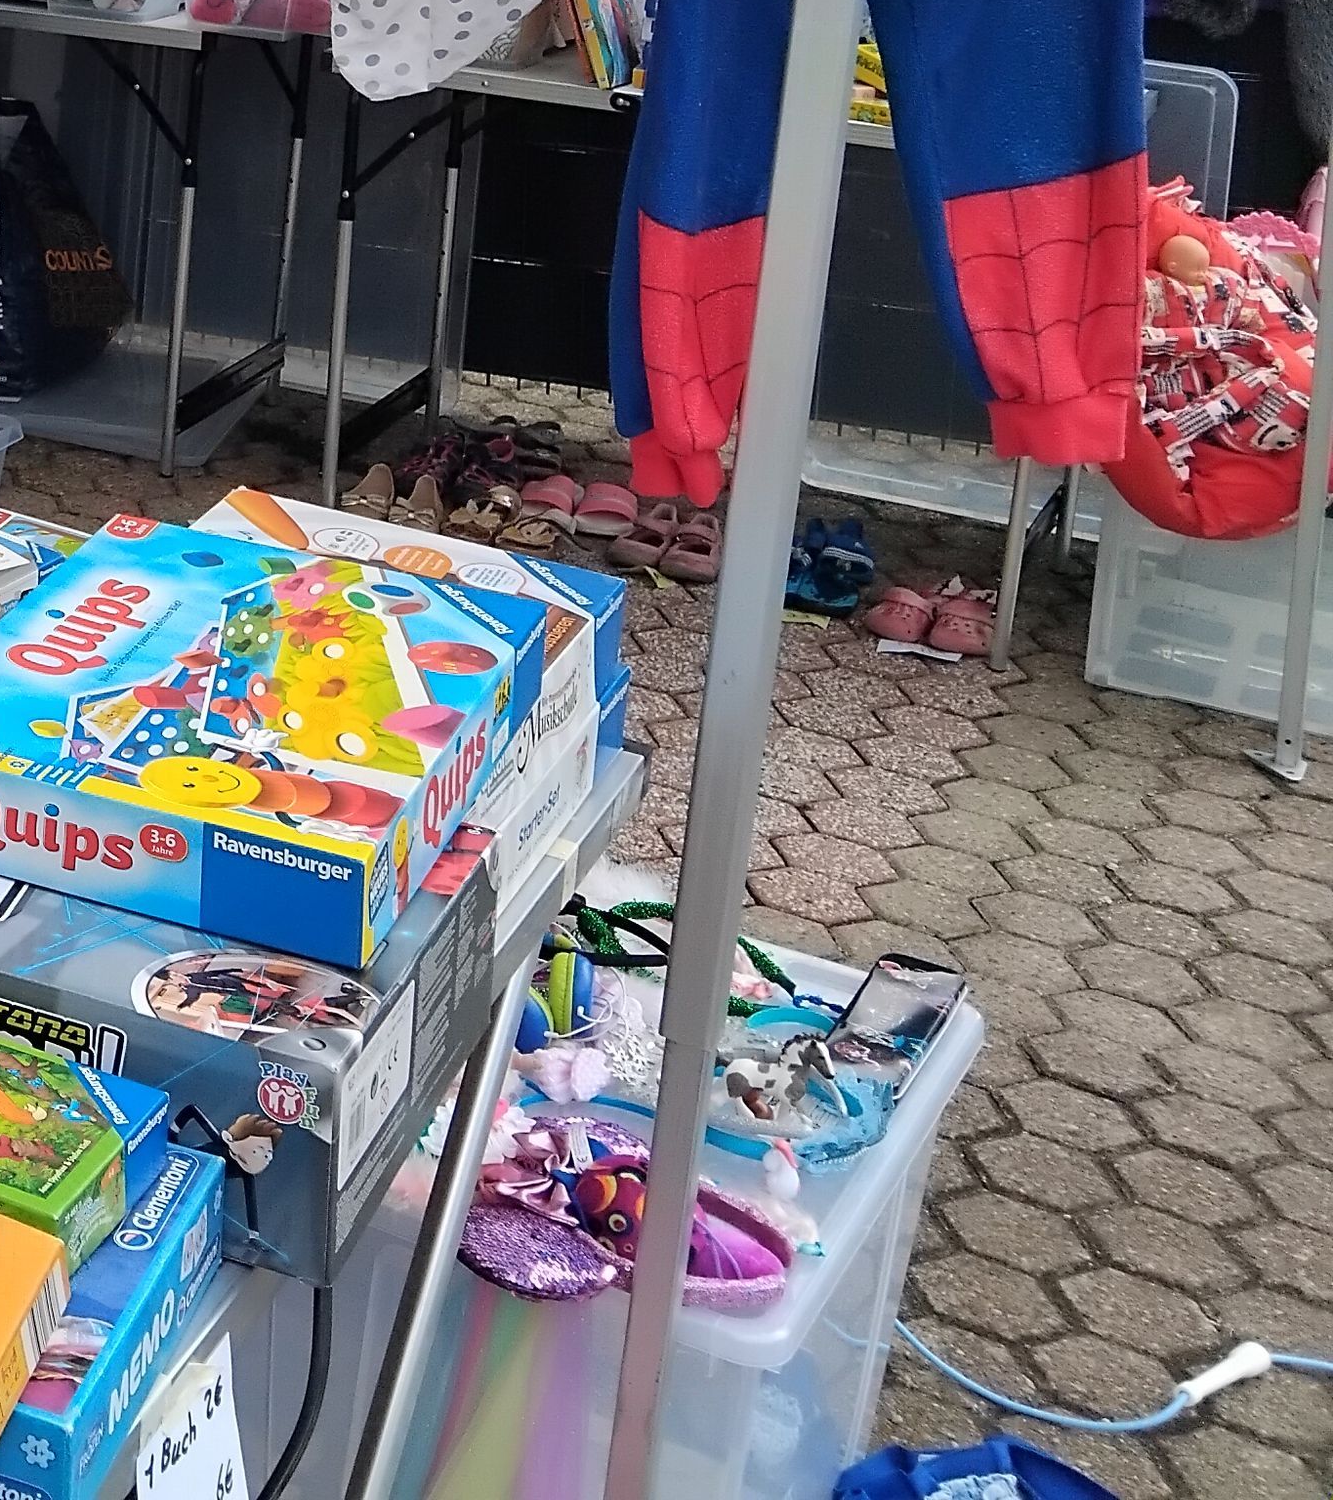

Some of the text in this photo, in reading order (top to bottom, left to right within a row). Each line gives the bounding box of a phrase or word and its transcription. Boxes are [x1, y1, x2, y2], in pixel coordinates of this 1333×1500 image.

[6, 578, 151, 676] Quips
[434, 583, 514, 635] Ravensburger
[423, 718, 487, 849] Quips
[149, 828, 177, 848] 3-6
[151, 844, 175, 857] Jahre
[213, 831, 353, 881] Ravensburger
[79, 1065, 130, 1127] Ravensburger
[258, 1061, 309, 1088] Play
[127, 1103, 170, 1156] Ravensburger
[107, 1288, 175, 1436] MEMO
[144, 1374, 223, 1489] 1 Buch 2€
